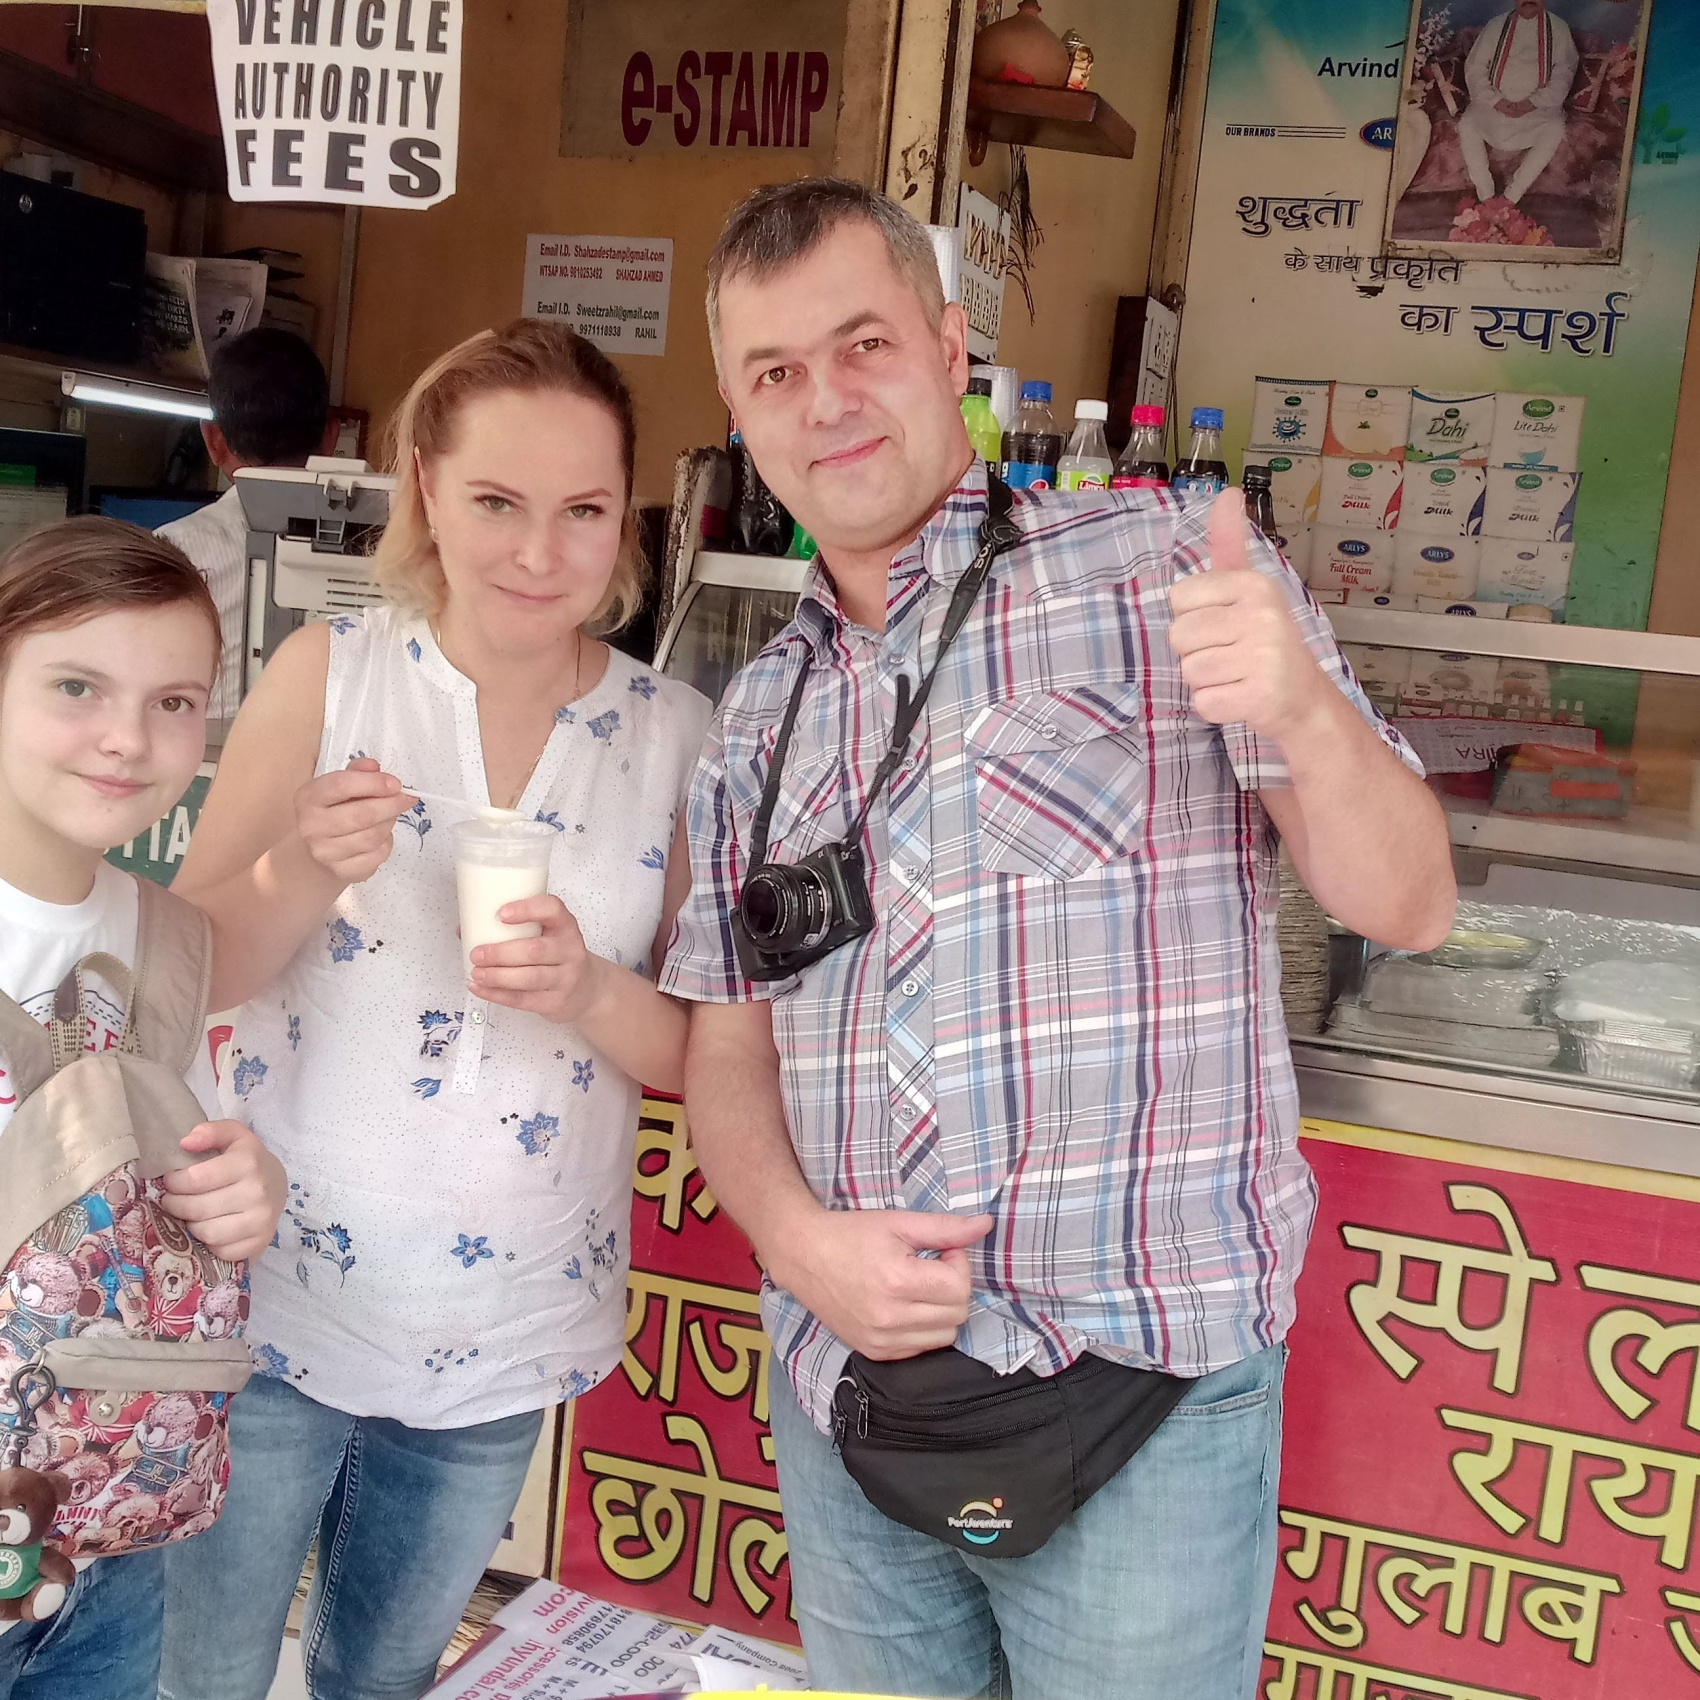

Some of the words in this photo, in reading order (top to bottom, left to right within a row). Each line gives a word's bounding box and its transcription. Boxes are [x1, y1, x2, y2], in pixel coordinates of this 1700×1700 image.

[235, 0, 451, 54] VEHICLE
[1317, 57, 1399, 78] Arvind
[235, 62, 443, 130] AUTHORITY
[621, 50, 830, 147] e-STAMP
[1225, 126, 1242, 136] OUR
[1243, 127, 1276, 138] BRANDS
[235, 129, 442, 198] FEES
[540, 243, 558, 256] Email
[1284, 247, 1308, 271] के
[1314, 253, 1363, 275] साथ
[616, 269, 643, 282] SHAHZAD
[643, 270, 664, 283] AHMED
[537, 301, 558, 315] Email
[635, 327, 658, 339] RAHIL
[1399, 303, 1459, 335] का
[1470, 291, 1632, 358] स्पर्श
[1426, 417, 1470, 438] Dahi
[1513, 420, 1532, 431] Lite
[1532, 422, 1559, 433] Dahi
[1426, 550, 1450, 560] ARLYS
[1346, 564, 1372, 575] Cream
[1279, 1508, 1626, 1668] गुलाब
